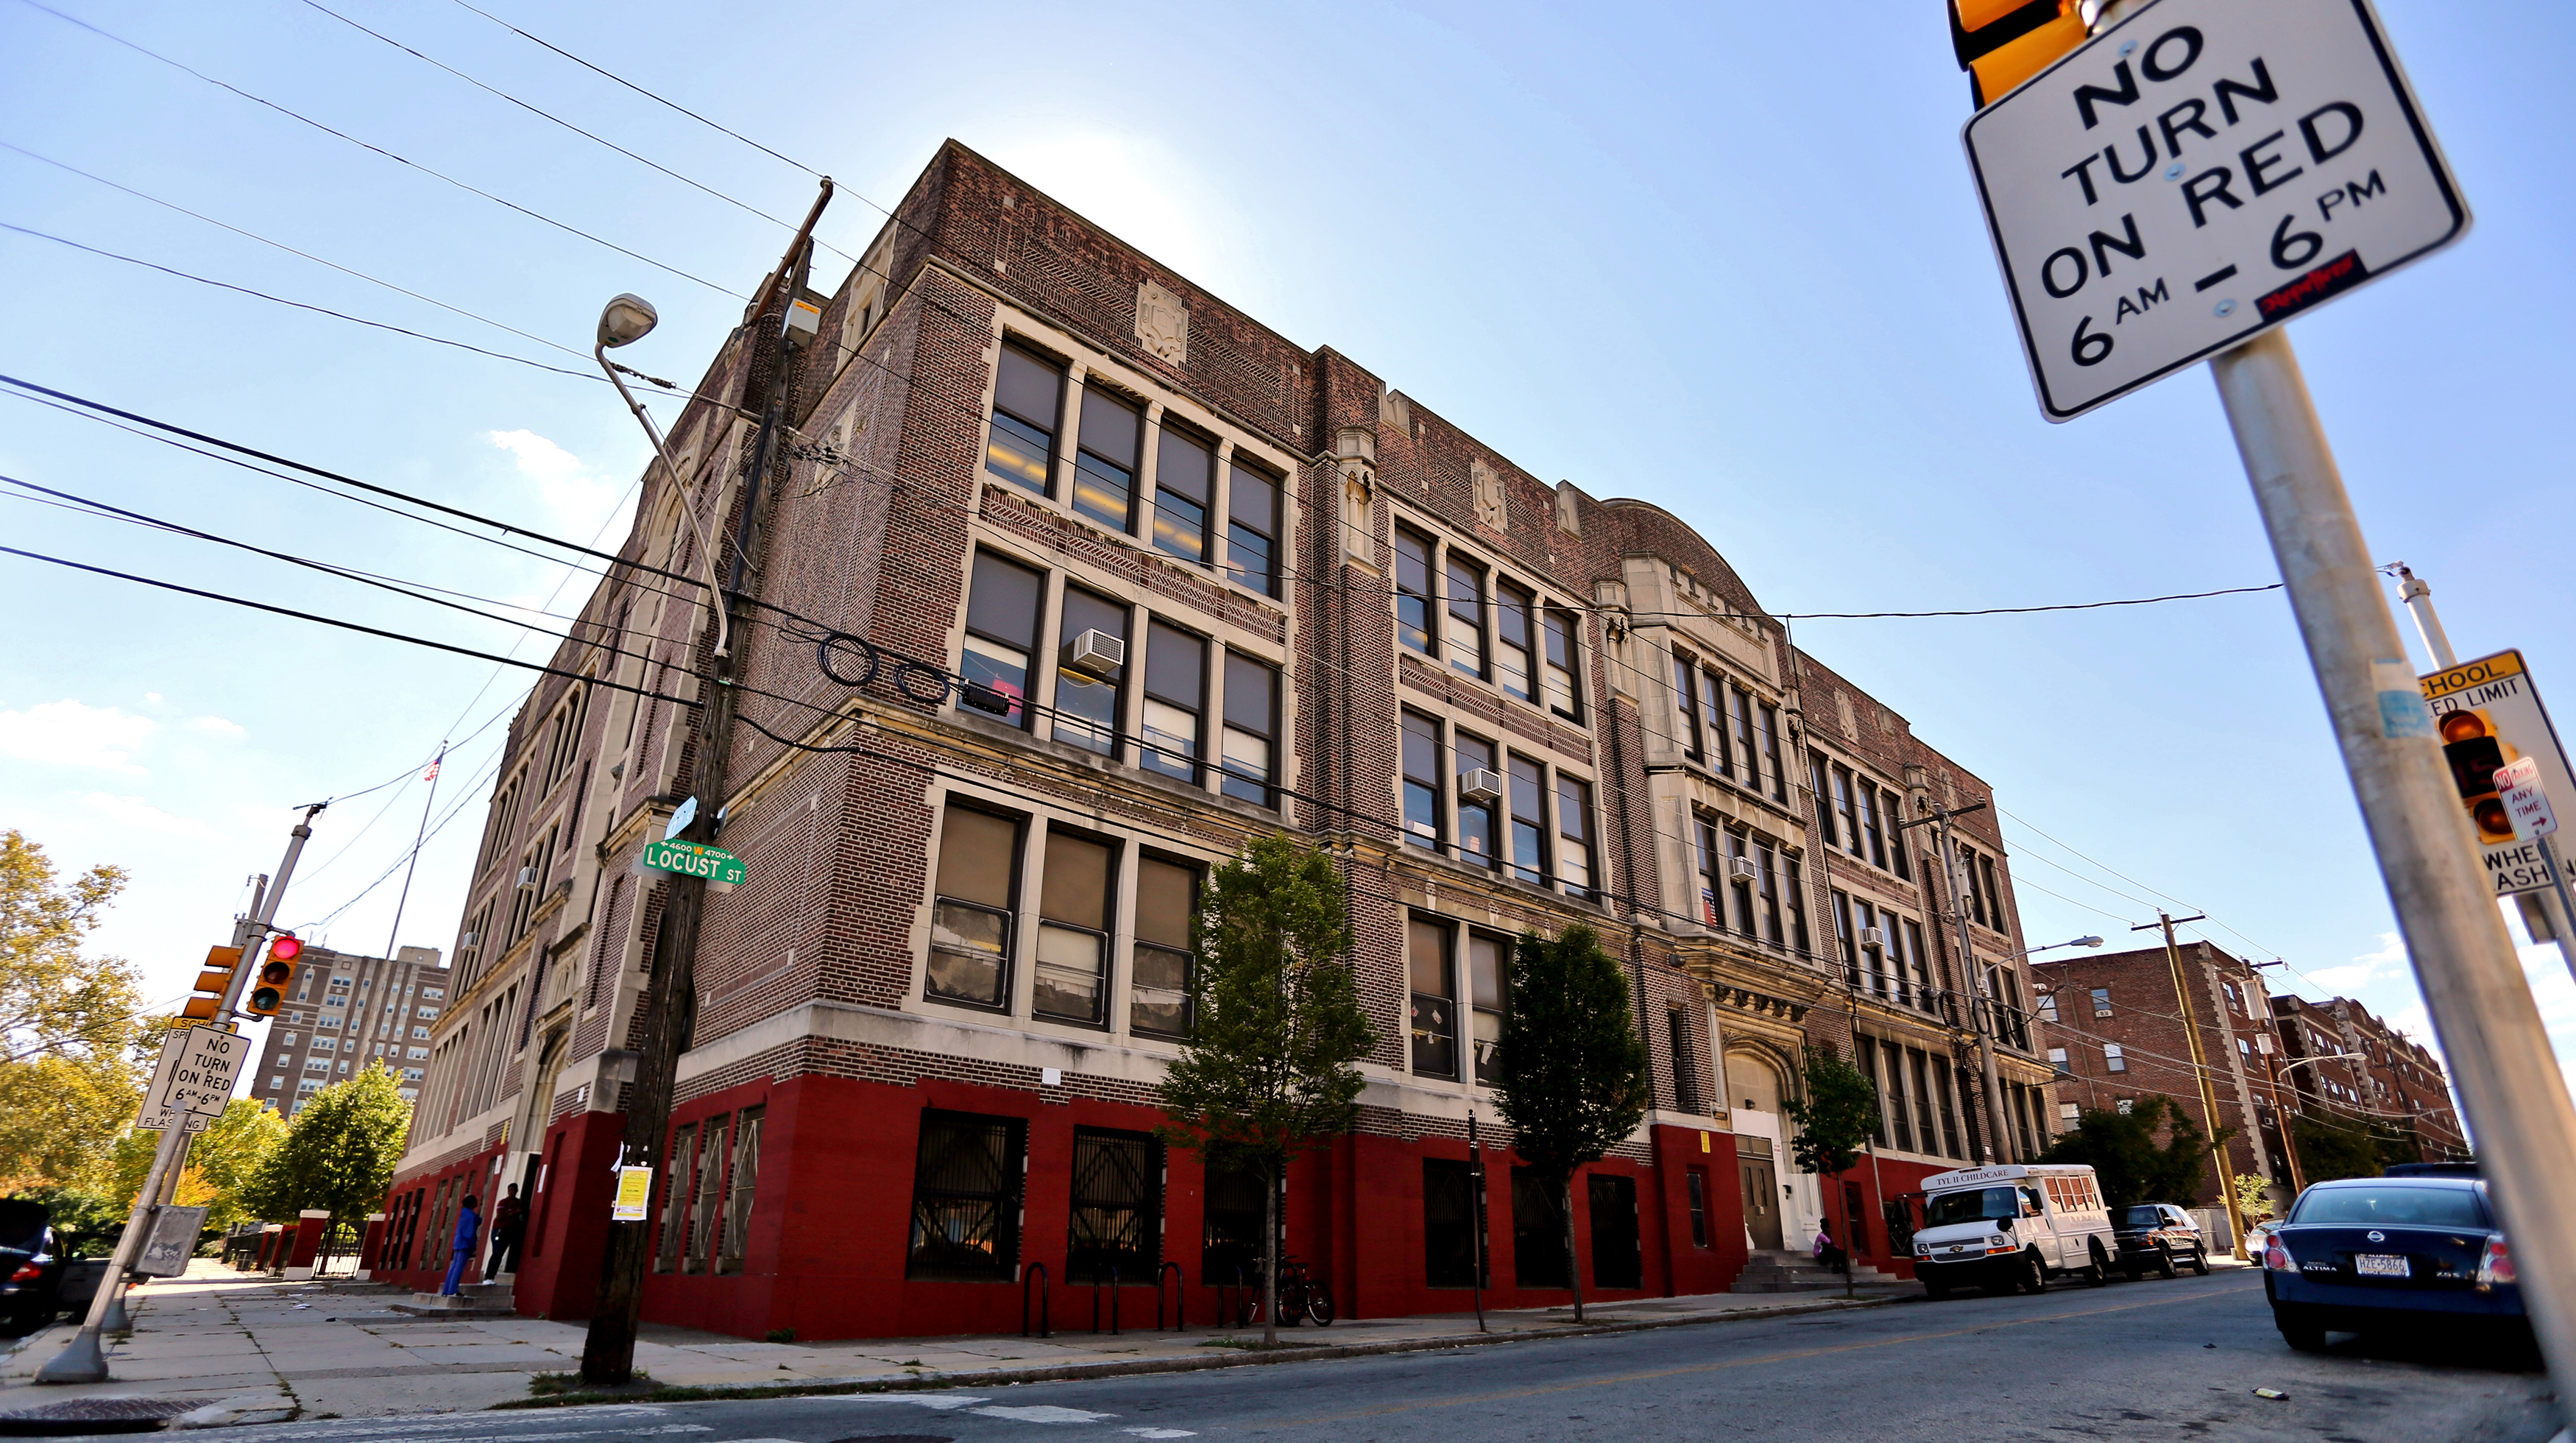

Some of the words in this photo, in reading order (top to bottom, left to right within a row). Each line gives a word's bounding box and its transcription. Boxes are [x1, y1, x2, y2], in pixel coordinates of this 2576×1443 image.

[2073, 25, 2204, 131] NO
[2061, 56, 2279, 206] TURN
[2041, 212, 2146, 299] ON
[2180, 100, 2364, 229] RED
[2420, 663, 2505, 696] HOOL
[2466, 678, 2518, 707] LIMIT
[2496, 772, 2511, 790] NO
[2512, 786, 2533, 804] ANY
[2515, 800, 2541, 818] TIME
[669, 843, 692, 853] 4600
[694, 846, 705, 856] W
[705, 850, 726, 859] 4700
[646, 847, 721, 878] LOCUST
[726, 869, 742, 882] ST
[206, 1038, 230, 1054] NO
[194, 1054, 230, 1073] TURN
[178, 1069, 200, 1084] ON
[203, 1075, 230, 1091] RED
[1936, 1177, 1952, 1185] TYL
[1961, 1169, 2009, 1182] CHILDCARE
